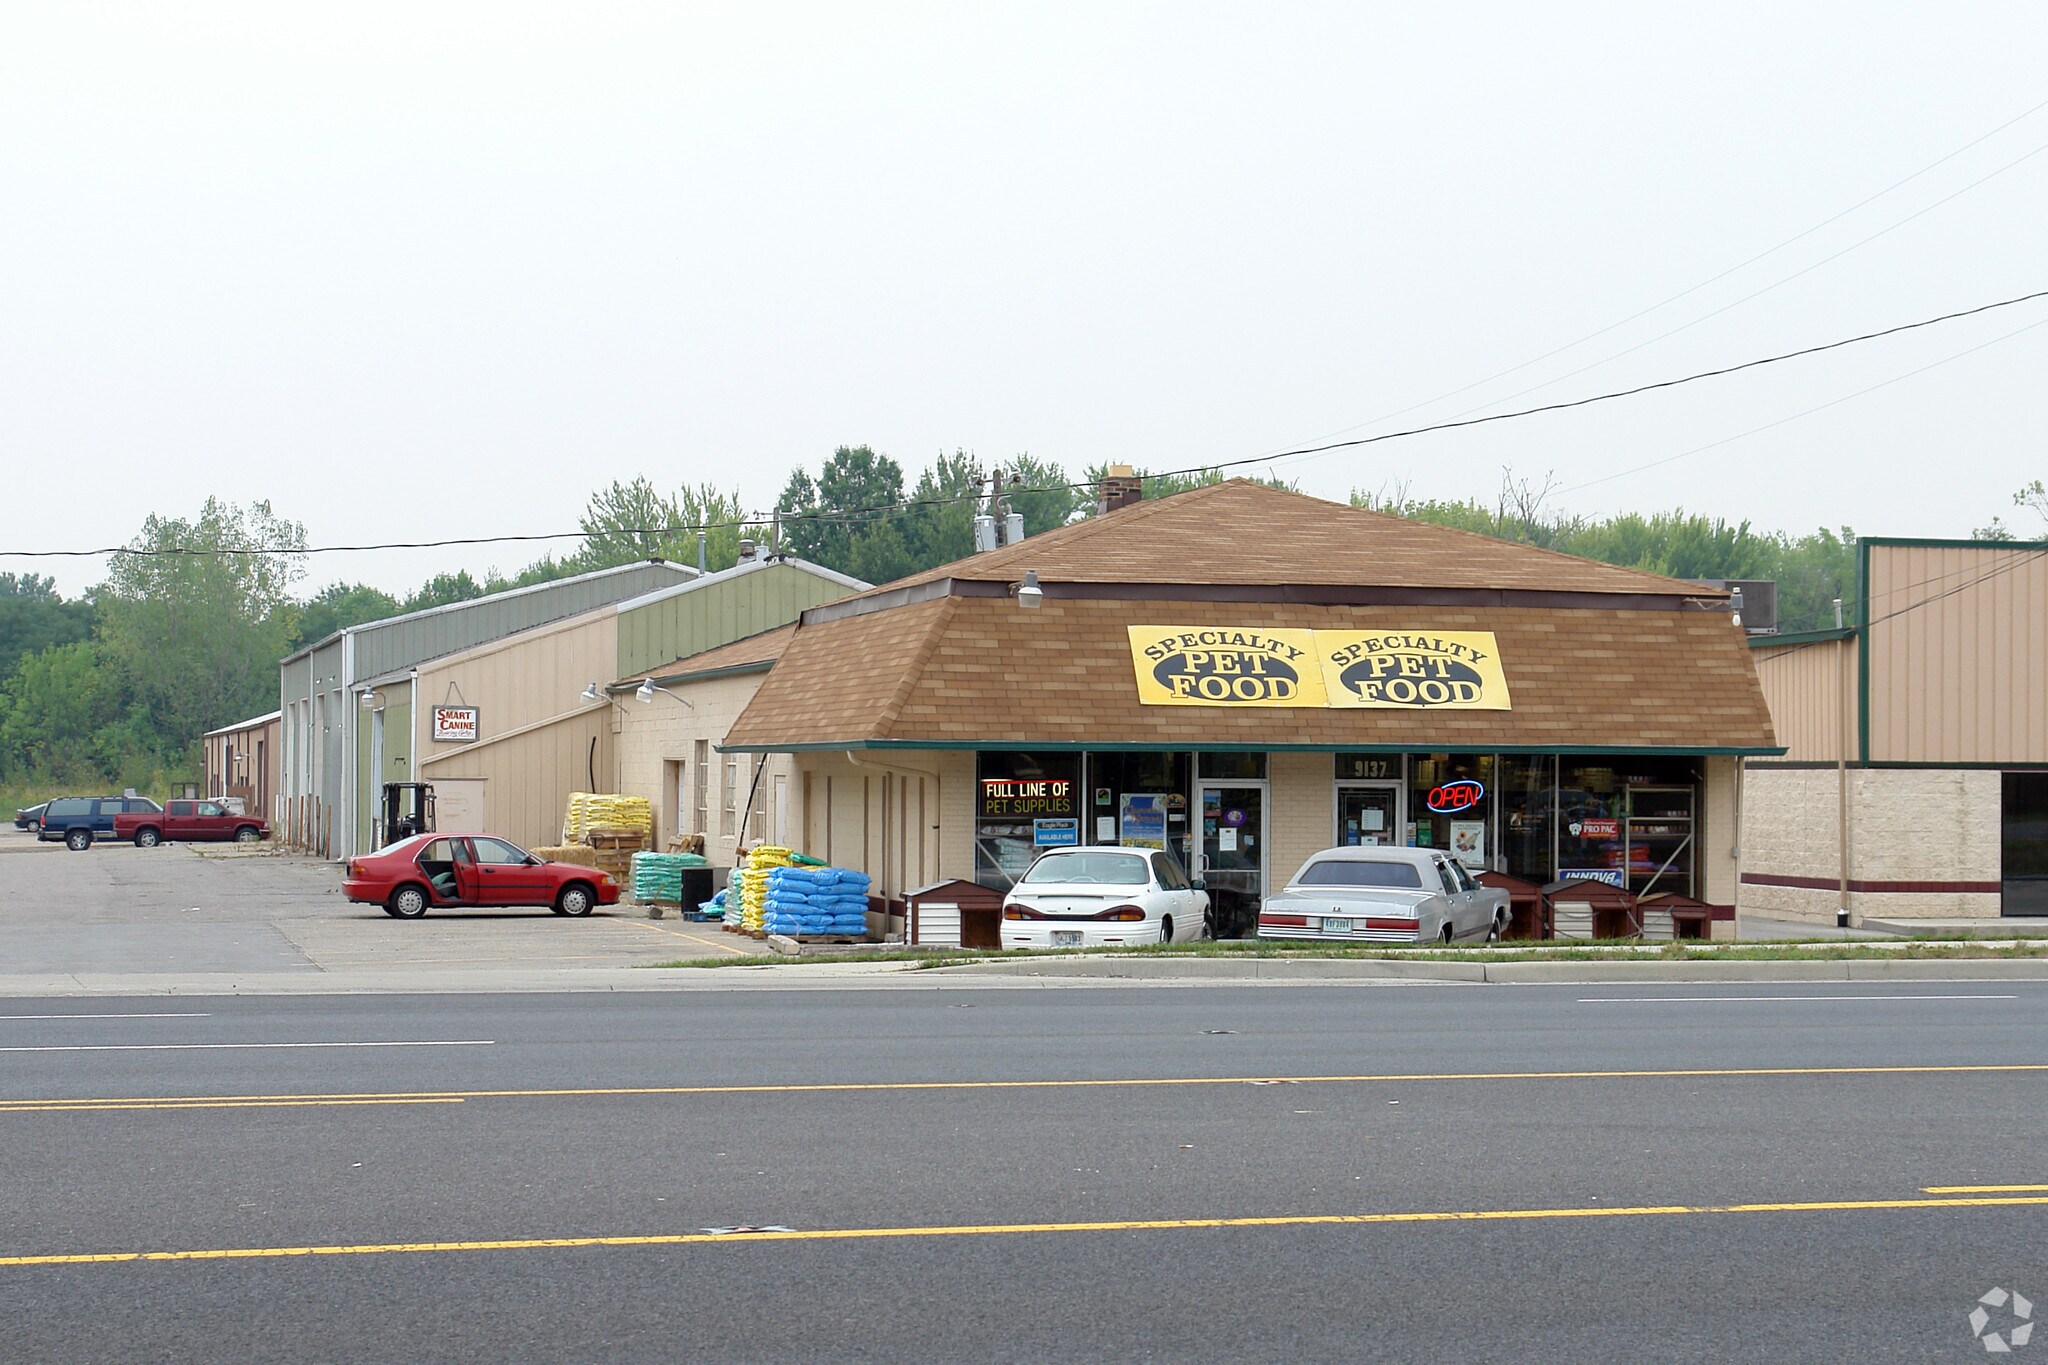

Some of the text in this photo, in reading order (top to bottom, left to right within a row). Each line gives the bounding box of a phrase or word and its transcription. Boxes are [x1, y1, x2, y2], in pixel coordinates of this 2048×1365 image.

[1143, 630, 1306, 662] SPECIALTY
[1330, 635, 1489, 668] SPECIALTY
[1179, 649, 1271, 675] PET
[1365, 653, 1454, 679] PET
[1167, 673, 1300, 702] FOOD
[1354, 677, 1483, 704] FOOD
[437, 708, 472, 720] SMART
[440, 720, 475, 730] CANINE
[1354, 760, 1387, 777] 9137
[986, 782, 1069, 798] FULL LINE OF
[1427, 786, 1479, 807] OPEN
[986, 798, 1071, 814] PET SUPPLIES
[1583, 824, 1616, 833] PRO PAC
